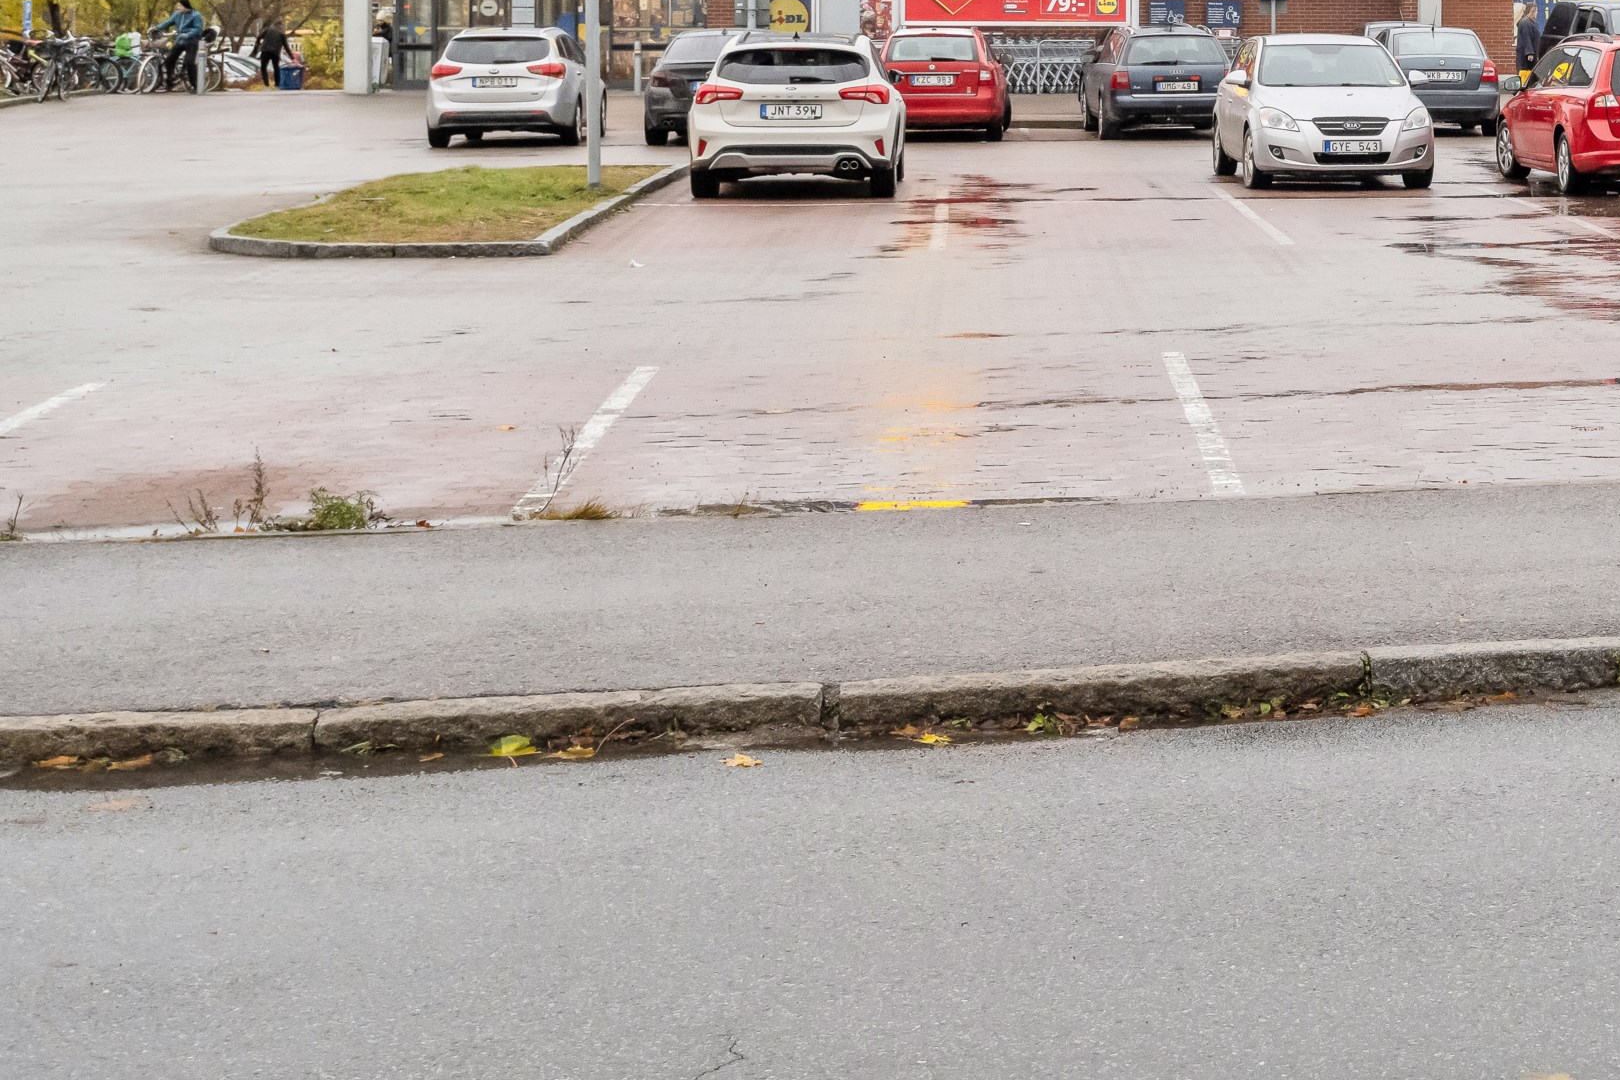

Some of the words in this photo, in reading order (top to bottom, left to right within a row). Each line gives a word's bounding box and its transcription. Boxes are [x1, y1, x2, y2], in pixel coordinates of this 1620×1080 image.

[916, 76, 931, 84] KZC
[936, 76, 952, 84] 983
[770, 105, 794, 116] JNT
[795, 105, 817, 116] 39W
[1331, 142, 1351, 152] GYE
[1358, 142, 1379, 152] 543
